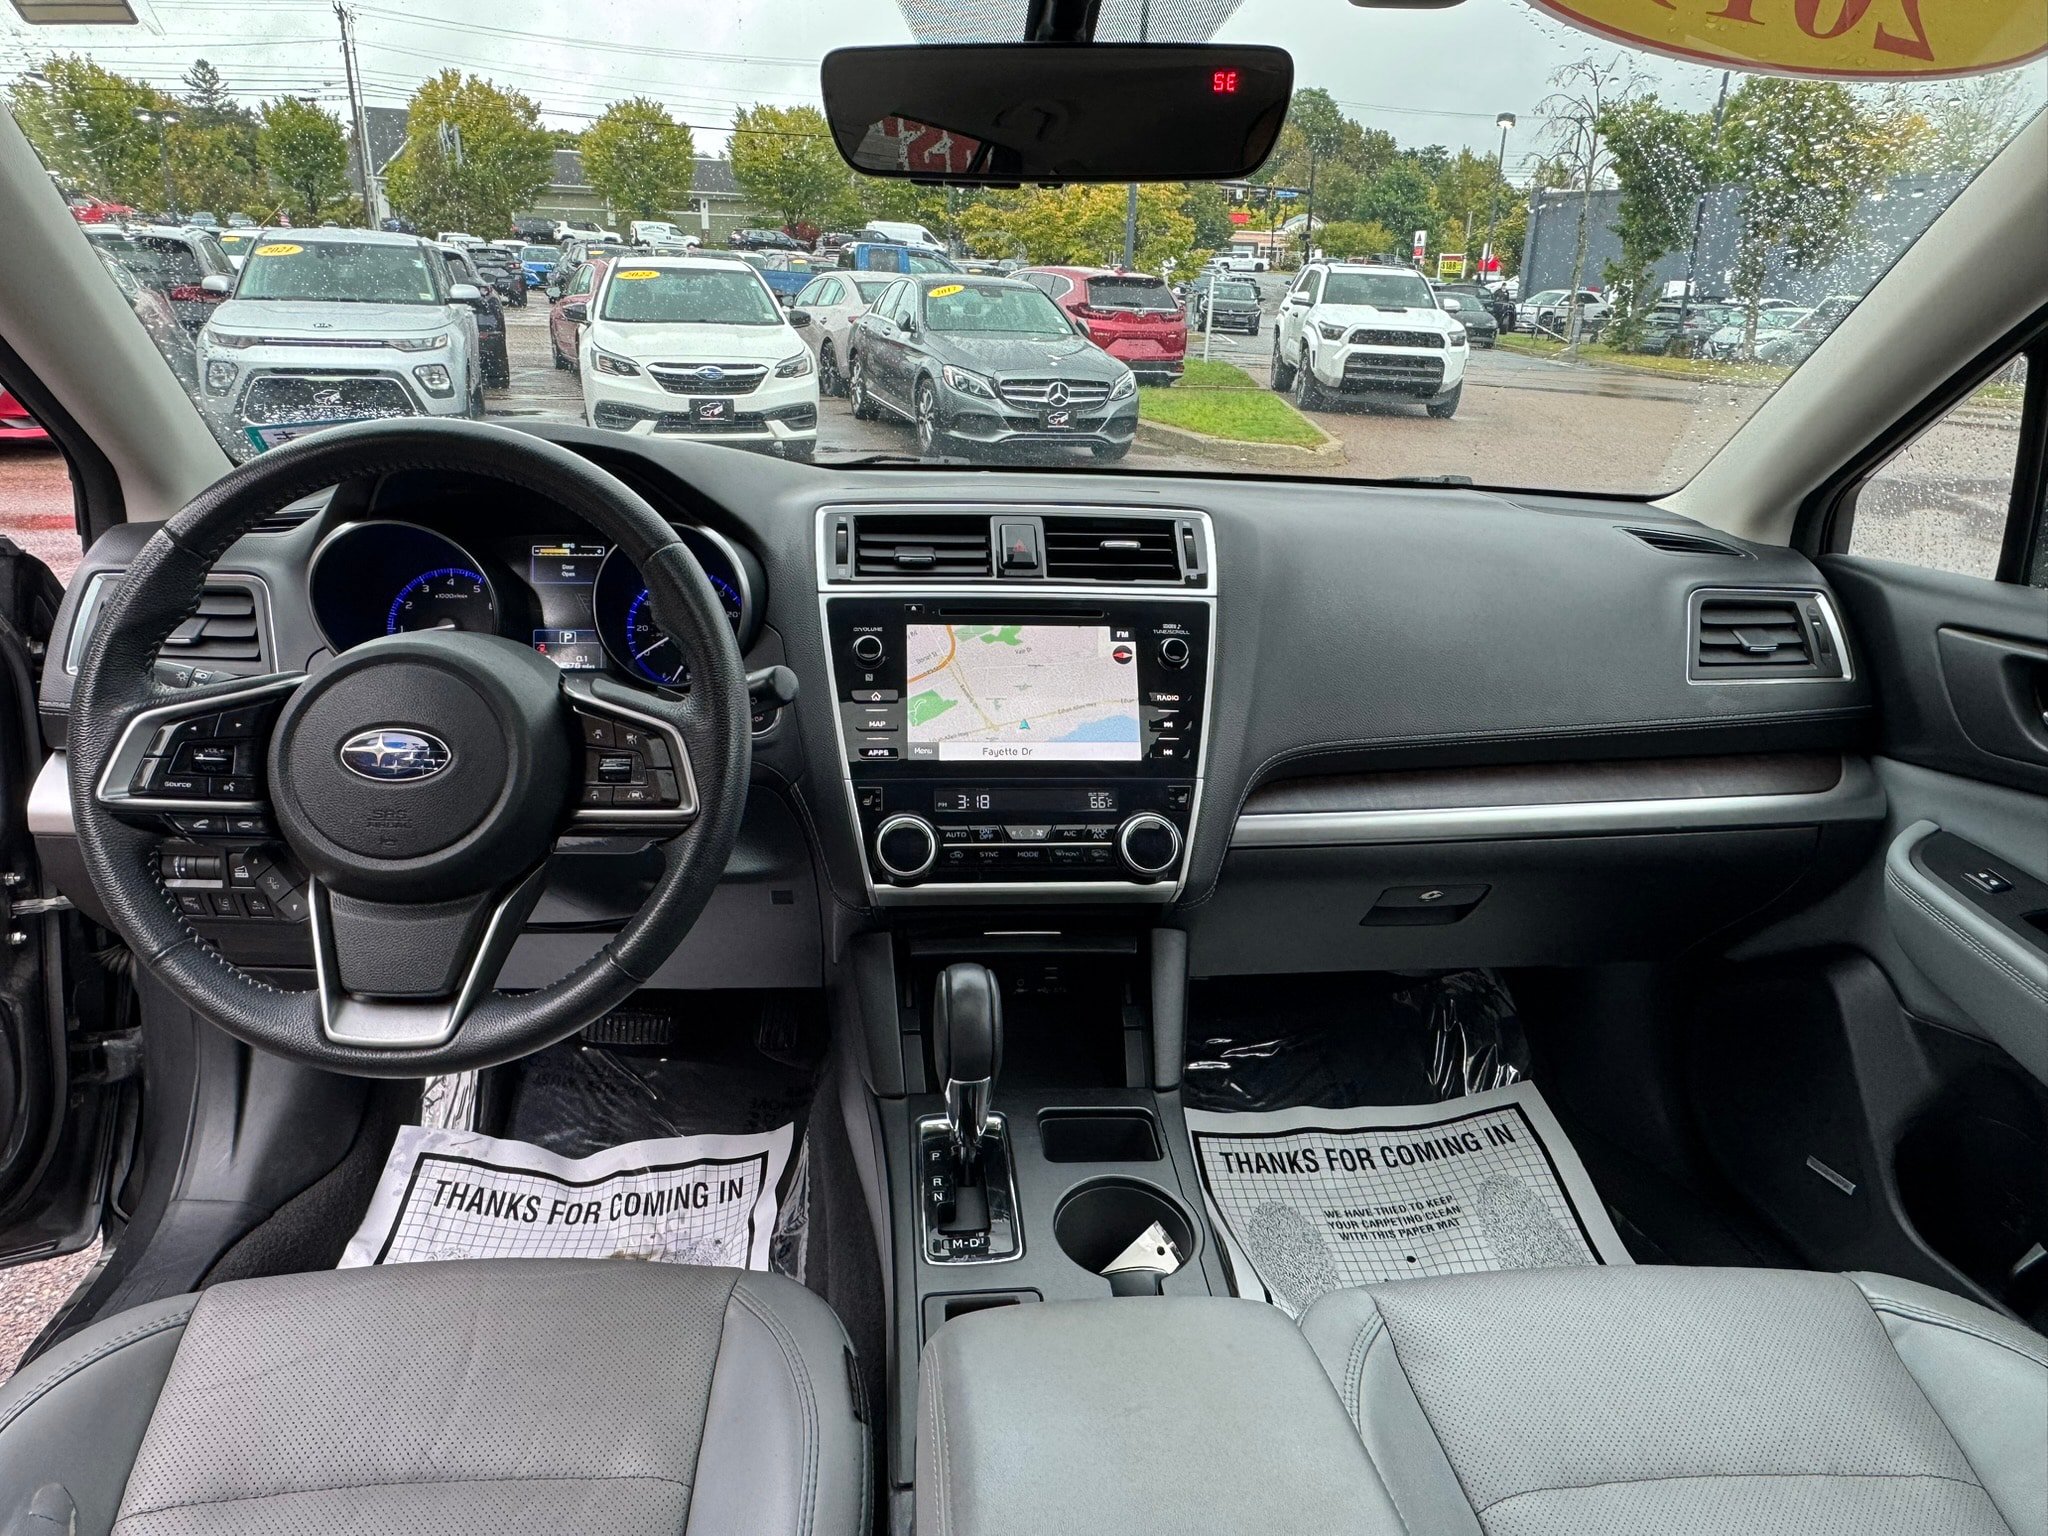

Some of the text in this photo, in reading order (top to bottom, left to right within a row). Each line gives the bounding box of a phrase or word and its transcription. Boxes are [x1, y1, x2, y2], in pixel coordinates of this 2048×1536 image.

[1213, 71, 1237, 92] SE
[446, 578, 455, 586] 4
[422, 584, 430, 592] 3
[473, 585, 481, 593] 5
[405, 601, 413, 610] 2
[563, 633, 572, 642] P
[914, 747, 932, 755] Menu
[982, 748, 1033, 758] Fayette Dr
[958, 795, 990, 809] 3:18
[1220, 1123, 1516, 1175] THANKS FOR COMING IN
[931, 1152, 941, 1162] P
[933, 1177, 942, 1187] R
[431, 1176, 744, 1226] THANKS FOR COMING IN
[934, 1192, 943, 1202] N
[1323, 1194, 1453, 1219] WE HAVE TRIED TO KEEP
[1327, 1205, 1461, 1230] YOUR CARPETING CLEAN
[1339, 1218, 1461, 1241] WITH THIS PAPER MAT
[952, 1238, 980, 1249] M-D
